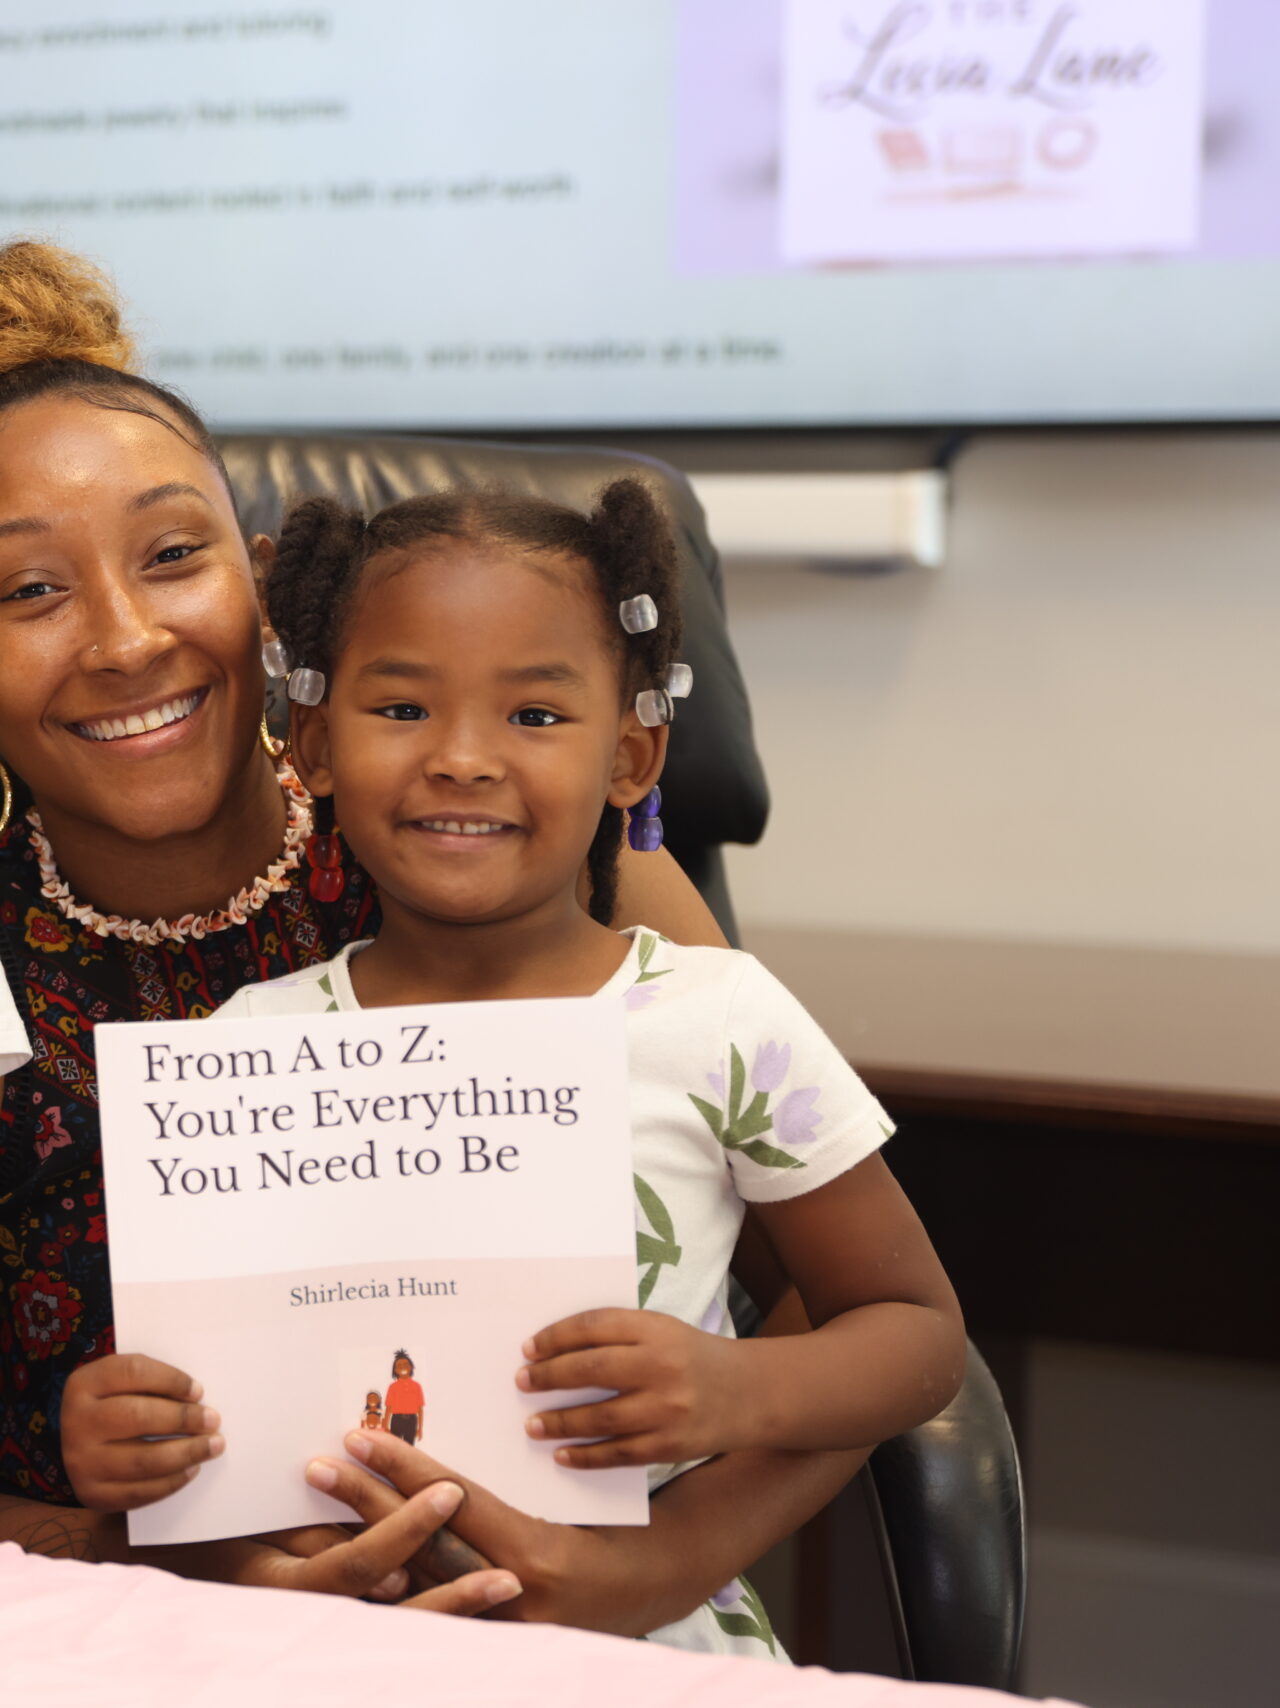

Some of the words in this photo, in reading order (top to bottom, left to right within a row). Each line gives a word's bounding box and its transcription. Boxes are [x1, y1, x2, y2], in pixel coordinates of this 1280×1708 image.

[143, 1044, 275, 1082] From
[290, 1035, 324, 1073] A
[337, 1039, 383, 1069] to
[400, 1025, 445, 1064] Z:
[144, 1095, 294, 1140] You're
[312, 1076, 580, 1131] Everything
[148, 1158, 240, 1196] You
[257, 1139, 379, 1190] Need
[396, 1147, 441, 1177] to
[459, 1136, 519, 1173] Be
[290, 1281, 390, 1307] Shirlecia
[397, 1277, 456, 1297] Hunt
